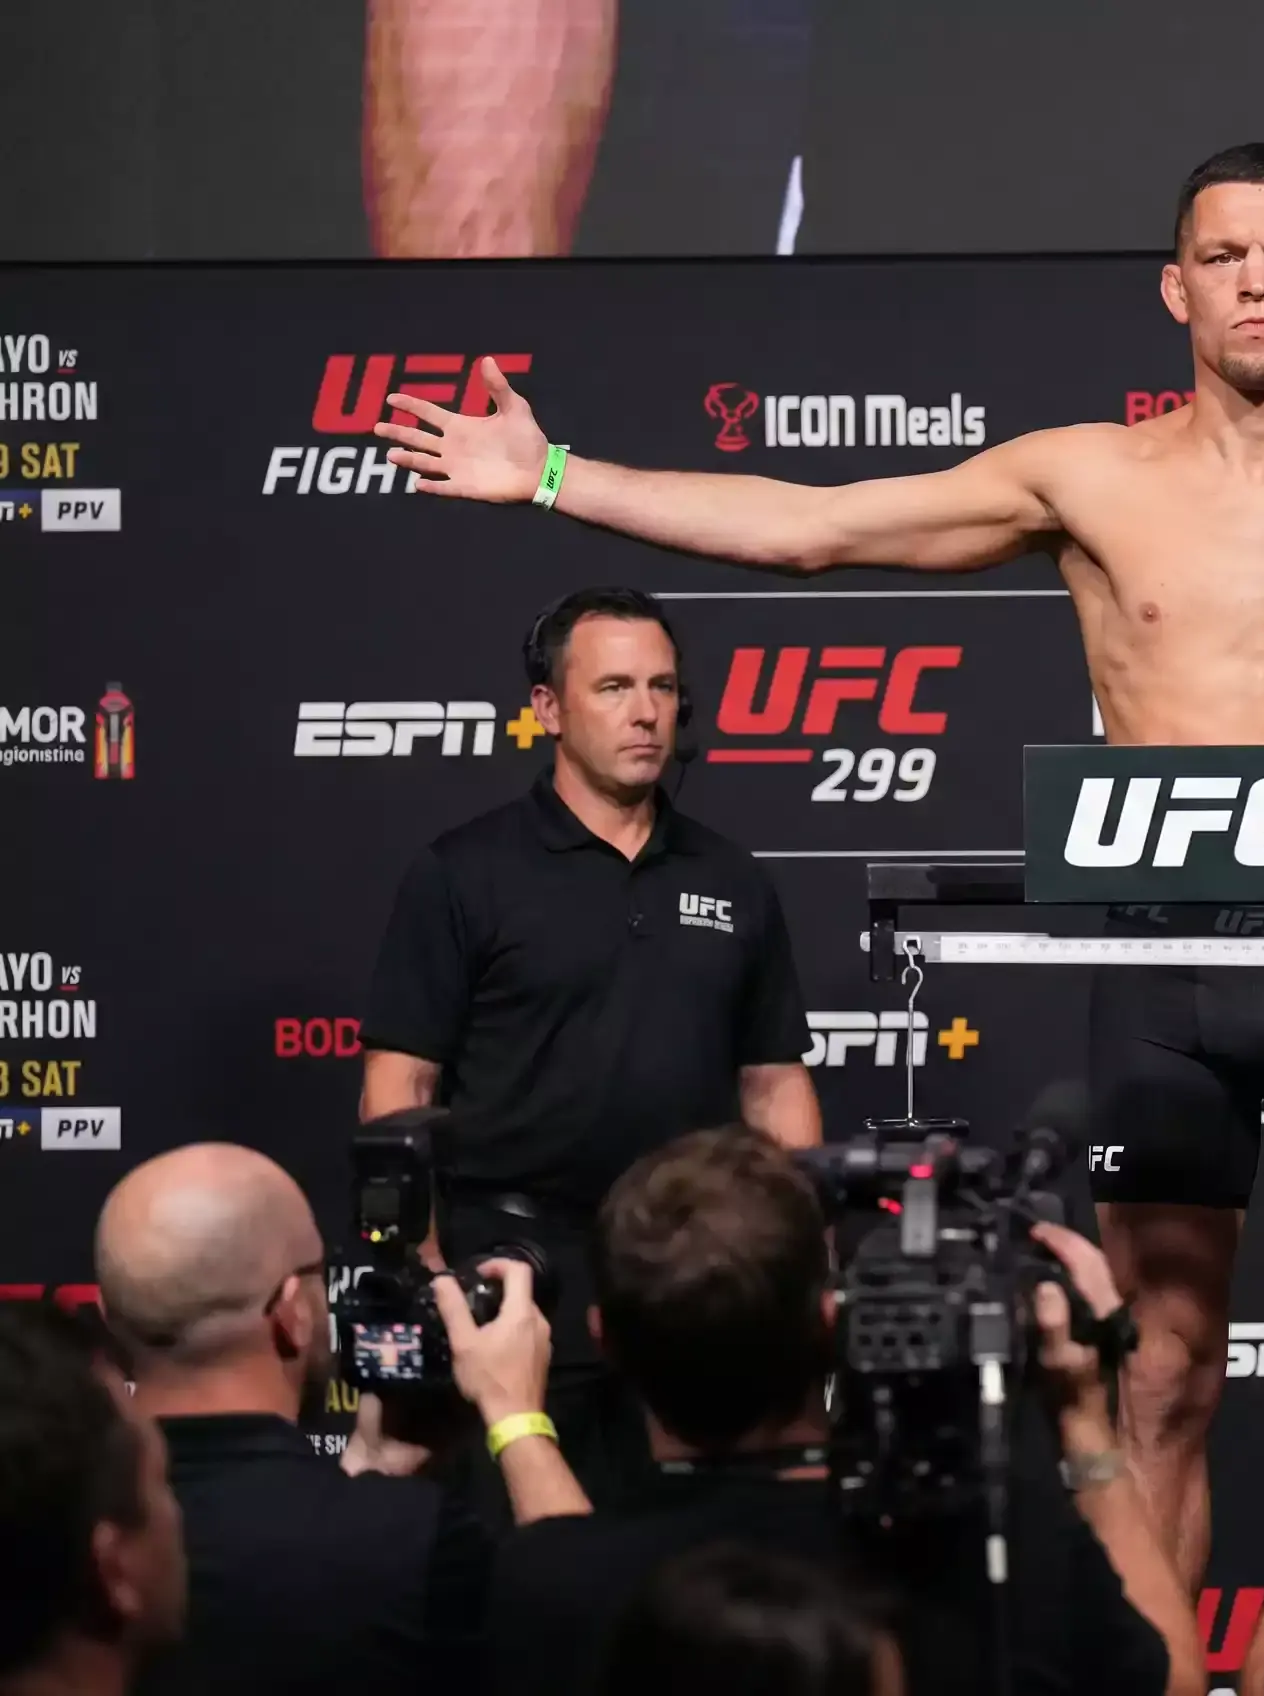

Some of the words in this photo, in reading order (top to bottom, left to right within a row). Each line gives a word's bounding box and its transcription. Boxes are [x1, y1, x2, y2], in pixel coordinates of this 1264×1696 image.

[0, 334, 50, 374] YO
[764, 395, 856, 447] ICON
[864, 392, 986, 446] Meals
[1125, 391, 1195, 427] BO
[21, 442, 81, 479] SAT
[262, 447, 422, 494] FIGH
[57, 501, 105, 520] PPV
[716, 646, 964, 735] UFC
[810, 748, 938, 802] 299
[679, 892, 733, 922] UFC
[21, 1060, 82, 1097] SAT
[57, 1119, 105, 1138] PPV
[1088, 1144, 1125, 1172] FC
